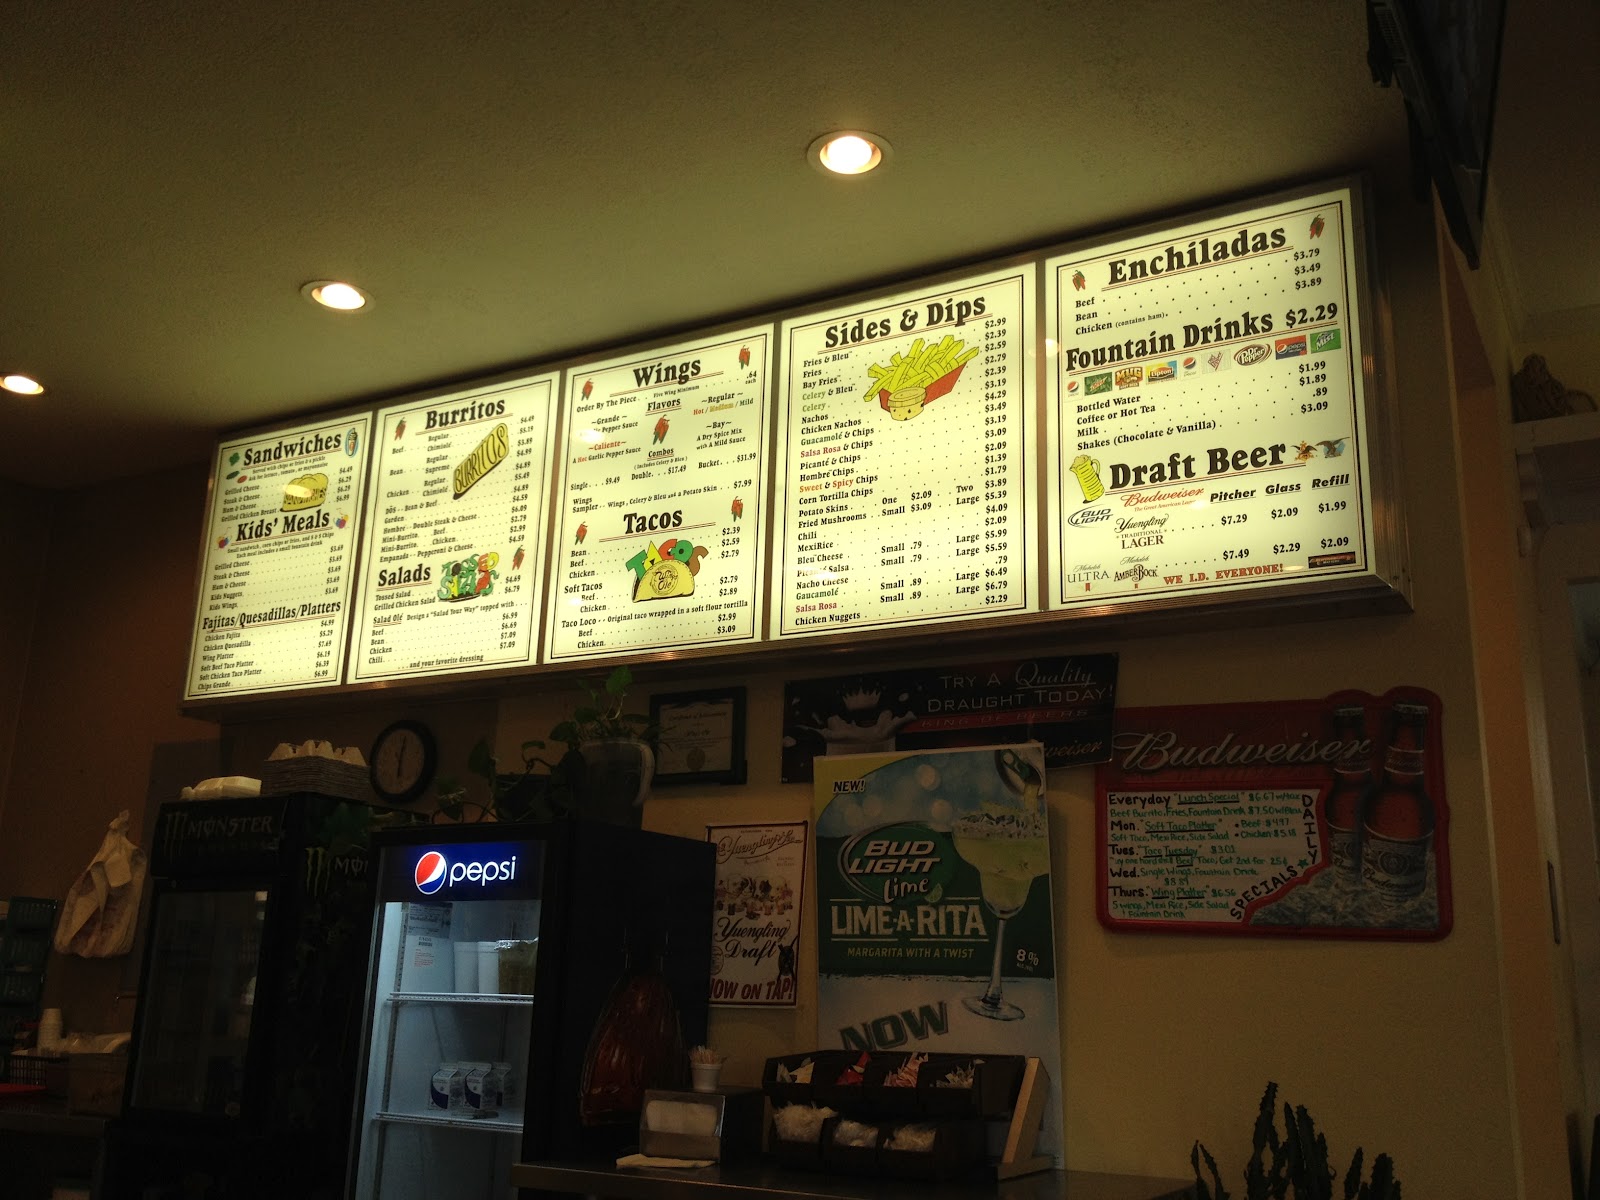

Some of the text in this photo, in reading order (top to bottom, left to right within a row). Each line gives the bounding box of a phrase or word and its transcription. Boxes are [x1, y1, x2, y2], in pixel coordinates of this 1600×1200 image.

[1107, 227, 1286, 285] Enchiladas
[1075, 247, 1320, 308] Beef $3.79
[1075, 262, 1321, 322] Bean $3.49
[825, 296, 986, 348] Sides & Dips
[803, 316, 1006, 368] Fries & Bleu $2.99
[1065, 331, 1176, 372] Fountain
[1182, 310, 1273, 349] Drinks
[1285, 302, 1338, 329] $2.29
[631, 359, 701, 393] Wings
[1149, 367, 1172, 378] Lipton
[646, 398, 681, 412] Flavors
[800, 389, 1006, 435] Chicken Nachos $4.29
[801, 377, 1006, 424] Nachos $3.19
[1076, 386, 1328, 437] Milk .89
[424, 399, 505, 430] Burritos
[1077, 400, 1328, 451] Shakes (Chocolate & Vanilla) $3.09
[243, 432, 342, 467] Sandwiches
[647, 447, 674, 458] Combos
[570, 452, 756, 491] Single $9.49 Double $17.49 Bucket $31.99
[1108, 442, 1286, 490] Draft Beer
[1120, 487, 1204, 507] Budweiser
[1209, 473, 1350, 502] Pitcher Glass Refill
[281, 508, 330, 534] Meals
[384, 515, 404, 524] Garden
[622, 509, 683, 535] Tacos
[798, 489, 1007, 528] Fried Mushrooms Small $3.09 Large $5.39
[1073, 513, 1114, 525] LIGHT
[1080, 508, 1112, 518] BUD
[1220, 500, 1347, 526] $7.29 $2.09 $1.99
[1114, 513, 1169, 533] Yuengling
[570, 525, 741, 557] Bean $2.39
[1121, 534, 1164, 549] LAGER
[1222, 536, 1349, 561] $7.49 $2.29 $2.09
[377, 562, 431, 587] Salads
[626, 539, 708, 583] TACOS
[1162, 562, 1284, 585] WE I.D. EVERYONE!
[1067, 570, 1110, 583] ULTRA
[373, 601, 395, 611] Grilled
[395, 599, 419, 608] Chicken
[420, 596, 436, 605] Salad
[579, 586, 737, 613] Chicken $2.89
[794, 593, 1008, 626] Chicken Nuggets $2.29
[201, 601, 341, 630] Fajitas/Quesadillas/Platters
[561, 620, 578, 628] Taco
[579, 618, 596, 626] Loco
[607, 612, 633, 623] Original
[648, 607, 676, 618] wrapped
[691, 604, 704, 613] soft
[705, 603, 722, 611] flour
[723, 599, 748, 609] tortilla
[939, 657, 1093, 689] TRY A Quality
[928, 685, 1113, 713] DRAUGHT TODAY!
[1112, 731, 1374, 772] Budweiser
[832, 779, 866, 794] NEW!
[1108, 794, 1171, 809] Everyday
[1111, 821, 1140, 831] Mon.
[1168, 821, 1187, 830] Taco
[1302, 794, 1317, 865] DAILY
[864, 839, 936, 857] BUD
[1108, 844, 1139, 856] Tues.
[448, 855, 517, 888] pepsi
[849, 857, 941, 874] LIGHT
[1110, 868, 1140, 878] Wed.
[1107, 886, 1148, 897] Thurs.
[1230, 865, 1298, 920] SPECIALS
[714, 916, 791, 942] Yuengling
[724, 940, 777, 966] Draft
[847, 947, 975, 959] MARGARITA WITH A TWIST
[742, 983, 761, 1000] ON
[765, 977, 794, 1000] TAP!
[840, 1001, 949, 1052] NOW
